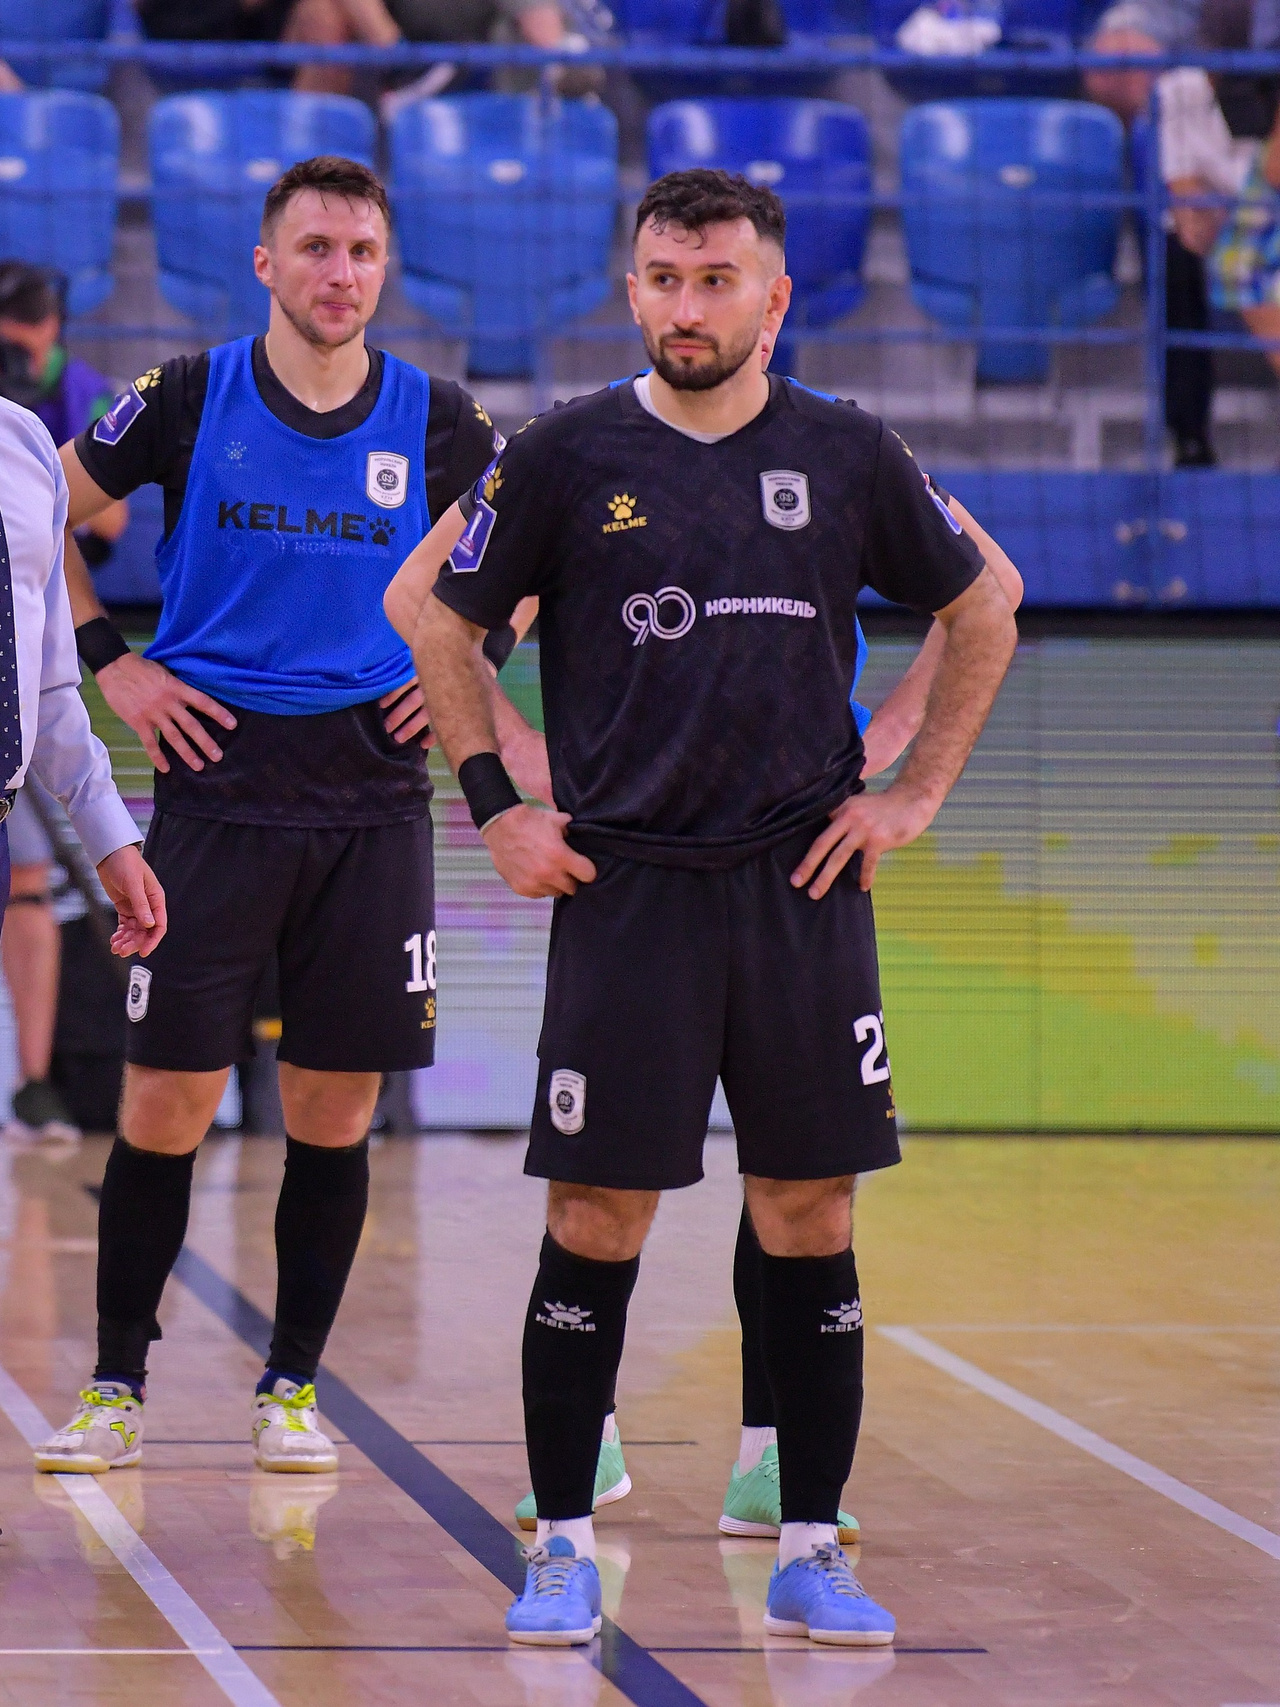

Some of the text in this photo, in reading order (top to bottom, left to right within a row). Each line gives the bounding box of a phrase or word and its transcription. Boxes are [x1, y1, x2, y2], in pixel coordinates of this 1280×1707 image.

[218, 501, 366, 542] KELME
[602, 516, 648, 534] KELME
[705, 597, 817, 618] НОРНИКЕЛЬ
[404, 930, 436, 993] 18
[853, 1010, 891, 1086] 2
[535, 1313, 596, 1332] KELME
